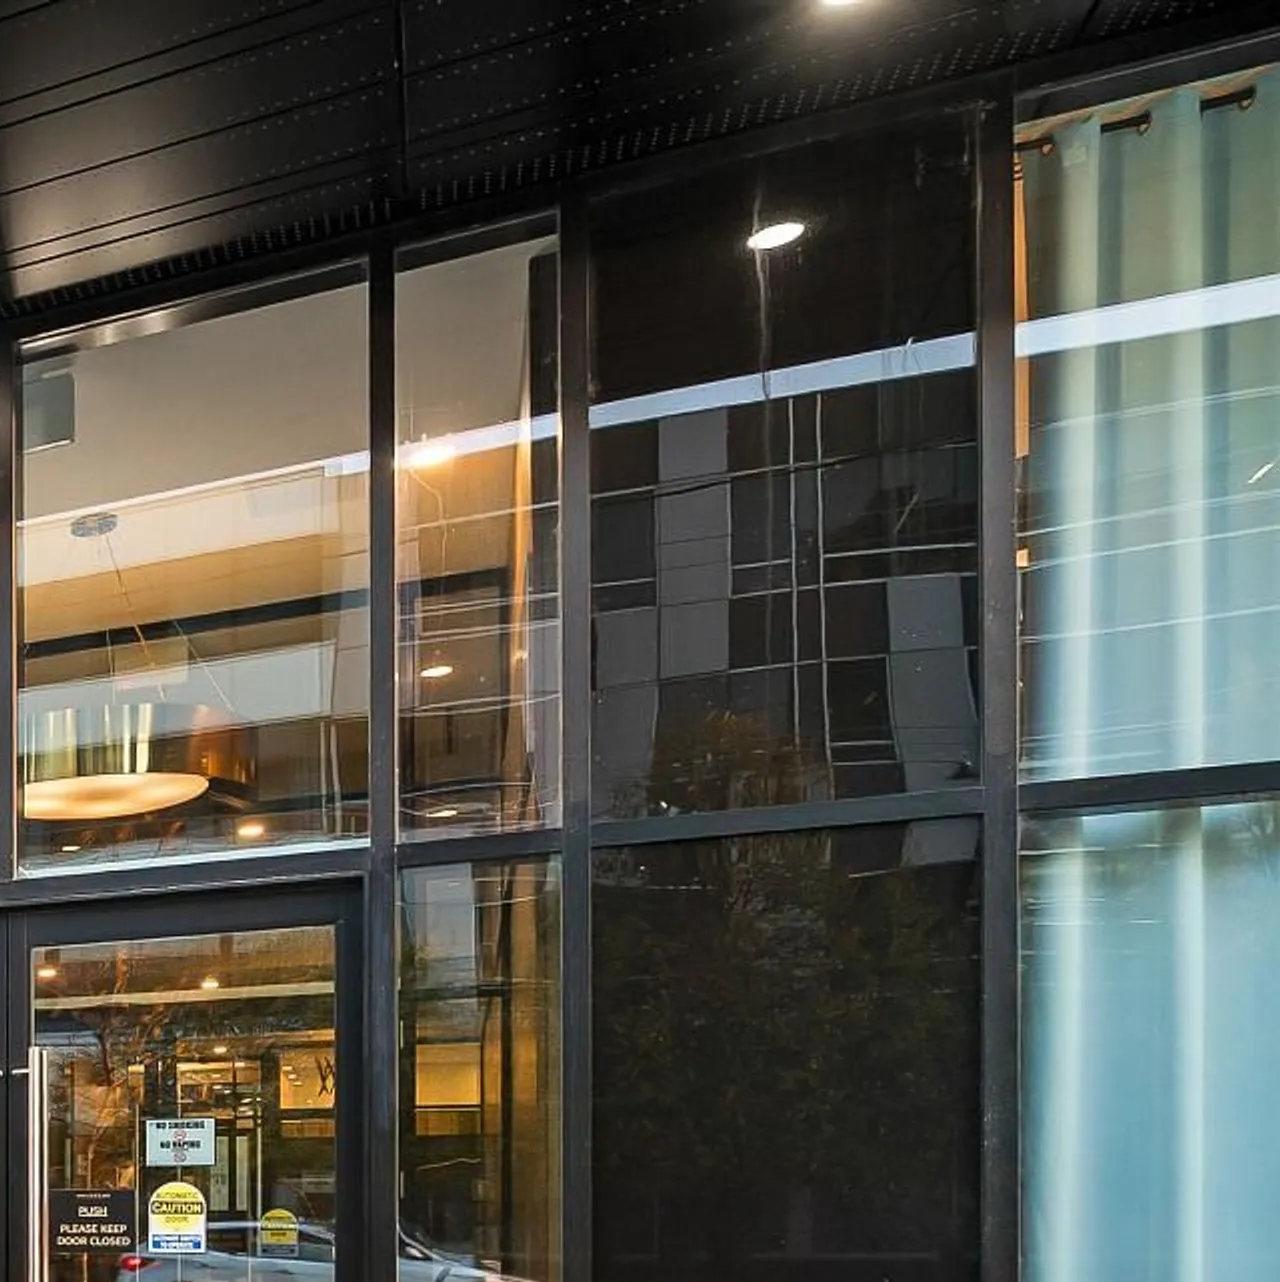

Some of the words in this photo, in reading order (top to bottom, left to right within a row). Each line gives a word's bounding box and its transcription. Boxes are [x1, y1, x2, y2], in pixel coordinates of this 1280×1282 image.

[78, 1205, 107, 1216] PUSH
[151, 1201, 202, 1214] CAUTION
[60, 1223, 98, 1233] PLEASE
[100, 1223, 128, 1233] KEEP
[57, 1236, 87, 1245] DOOR
[89, 1236, 131, 1246] CLOSED
